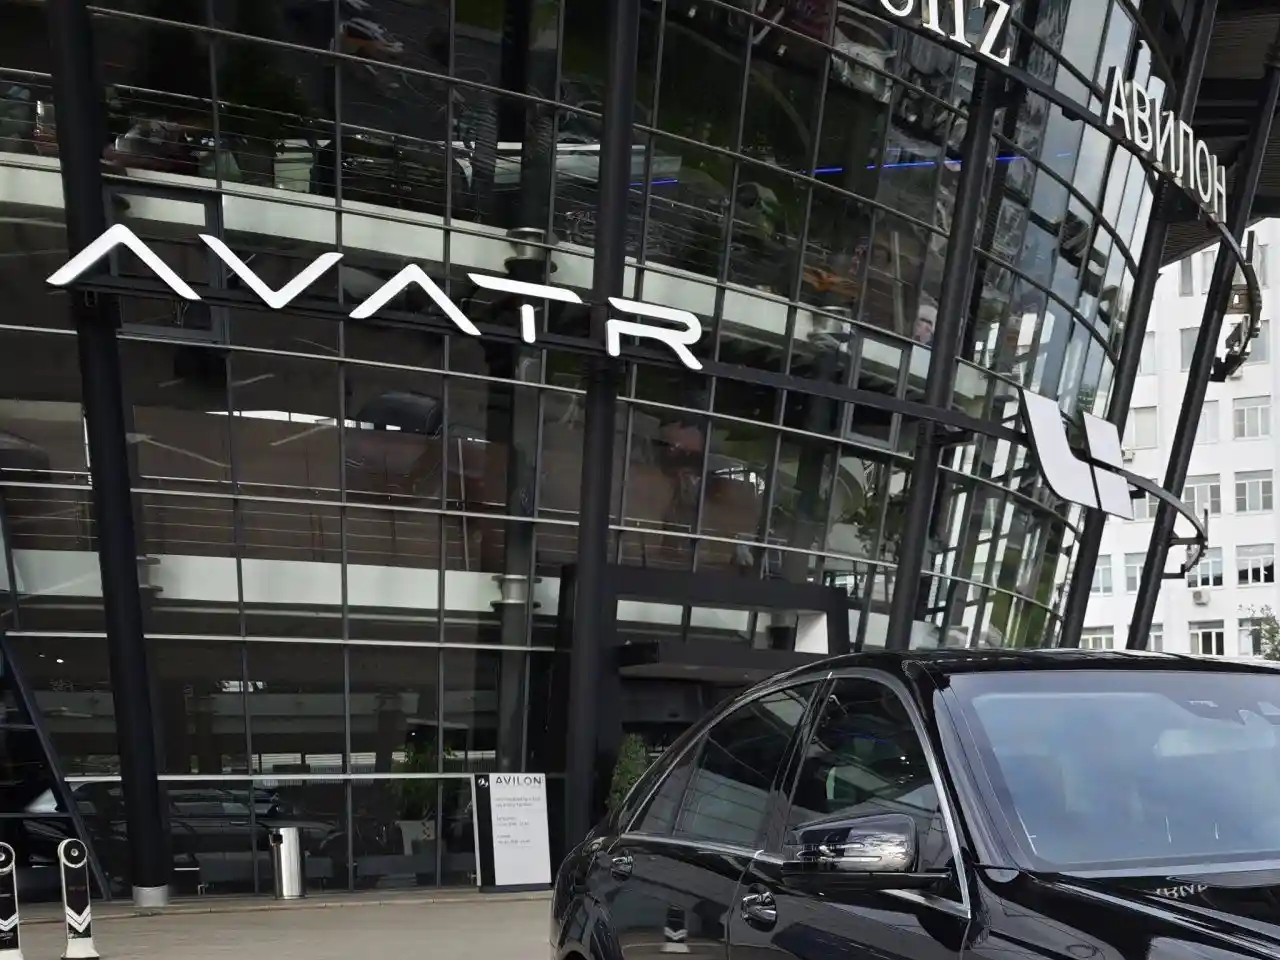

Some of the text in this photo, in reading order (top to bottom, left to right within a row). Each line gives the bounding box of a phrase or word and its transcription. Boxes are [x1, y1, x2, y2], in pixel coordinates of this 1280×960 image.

[1106, 65, 1228, 224] АВИЛОН
[46, 223, 704, 370] AVATR
[495, 776, 542, 786] AVILON
